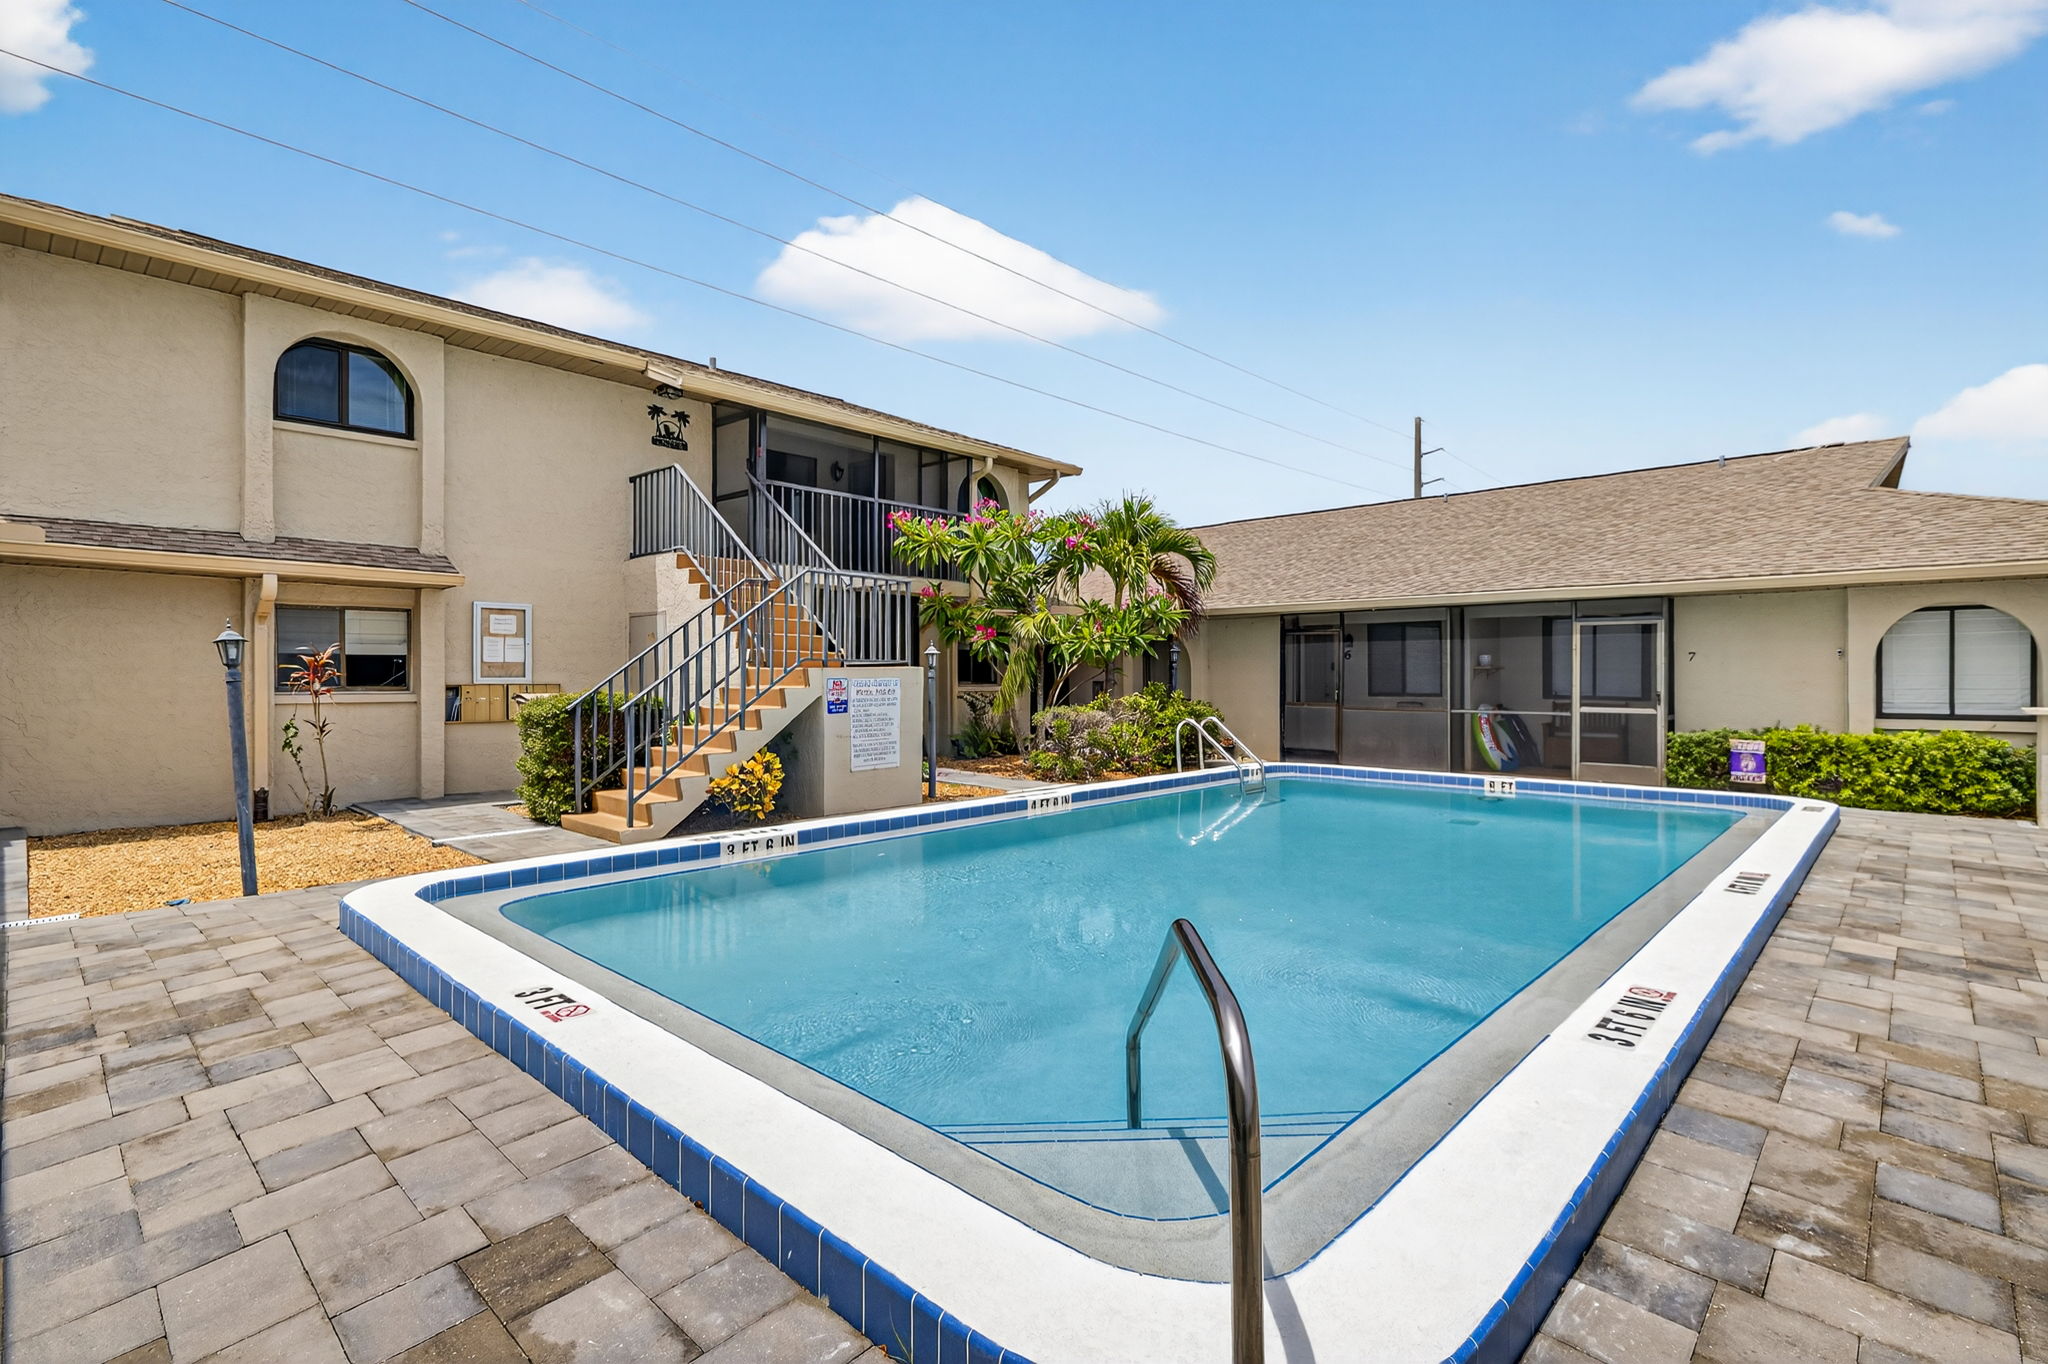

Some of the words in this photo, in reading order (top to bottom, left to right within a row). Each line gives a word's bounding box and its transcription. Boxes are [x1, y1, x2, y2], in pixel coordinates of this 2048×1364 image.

[1688, 651, 1696, 661] 7
[1501, 781, 1513, 790] FT
[1040, 798, 1050, 808] FT
[1061, 794, 1070, 806] IN
[742, 840, 758, 853] FT
[781, 834, 795, 848] IN
[514, 987, 553, 997] 3
[525, 993, 576, 1009] FT
[1617, 995, 1667, 1012] IN
[1611, 1009, 1656, 1020] 6
[1595, 1017, 1647, 1037] FT
[1587, 1033, 1635, 1047] 3
